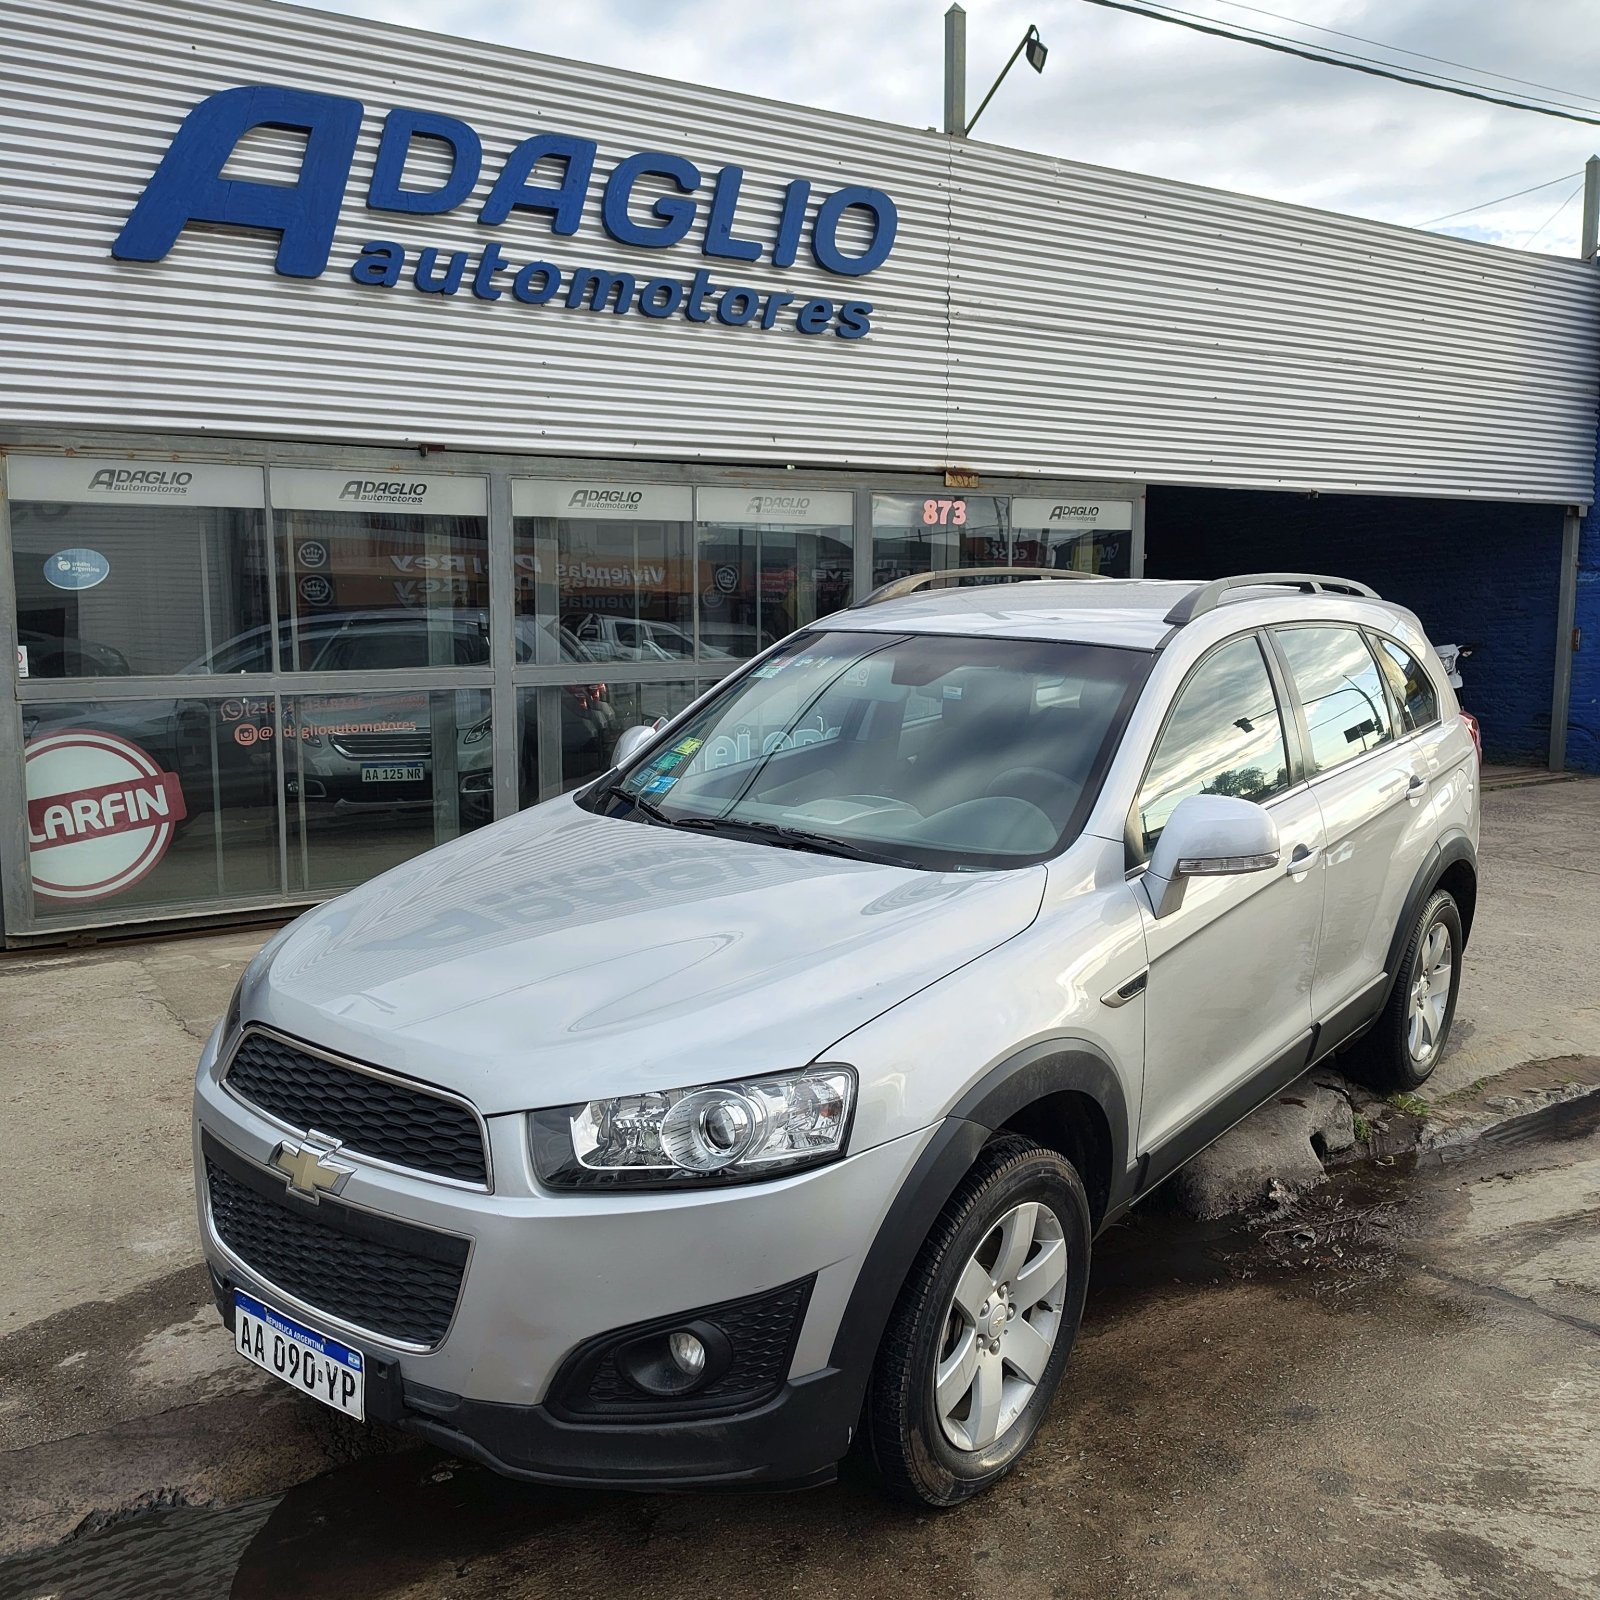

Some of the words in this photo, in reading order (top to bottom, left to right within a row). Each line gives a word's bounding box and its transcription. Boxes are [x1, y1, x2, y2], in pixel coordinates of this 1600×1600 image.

[112, 86, 899, 279] ADAGLIO
[351, 240, 874, 340] automotores
[88, 469, 193, 490] ADAGLIO
[113, 483, 188, 494] automotores
[339, 480, 427, 499] ADAGLIO
[360, 493, 423, 503] automotores
[568, 489, 643, 507] ADAGLIO
[586, 501, 639, 510] automotores
[745, 496, 811, 513] ADAGLIO
[922, 499, 967, 525] 873
[1049, 505, 1099, 520] ADAGLIO
[365, 769, 379, 780] AA
[382, 768, 403, 780] 125
[407, 768, 421, 779] NR
[265, 1315, 293, 1337] REPUBLICA
[293, 1331, 325, 1353] ARGENTINA
[241, 1315, 265, 1363] AA
[273, 1334, 316, 1390] 090
[325, 1360, 356, 1408] YP
